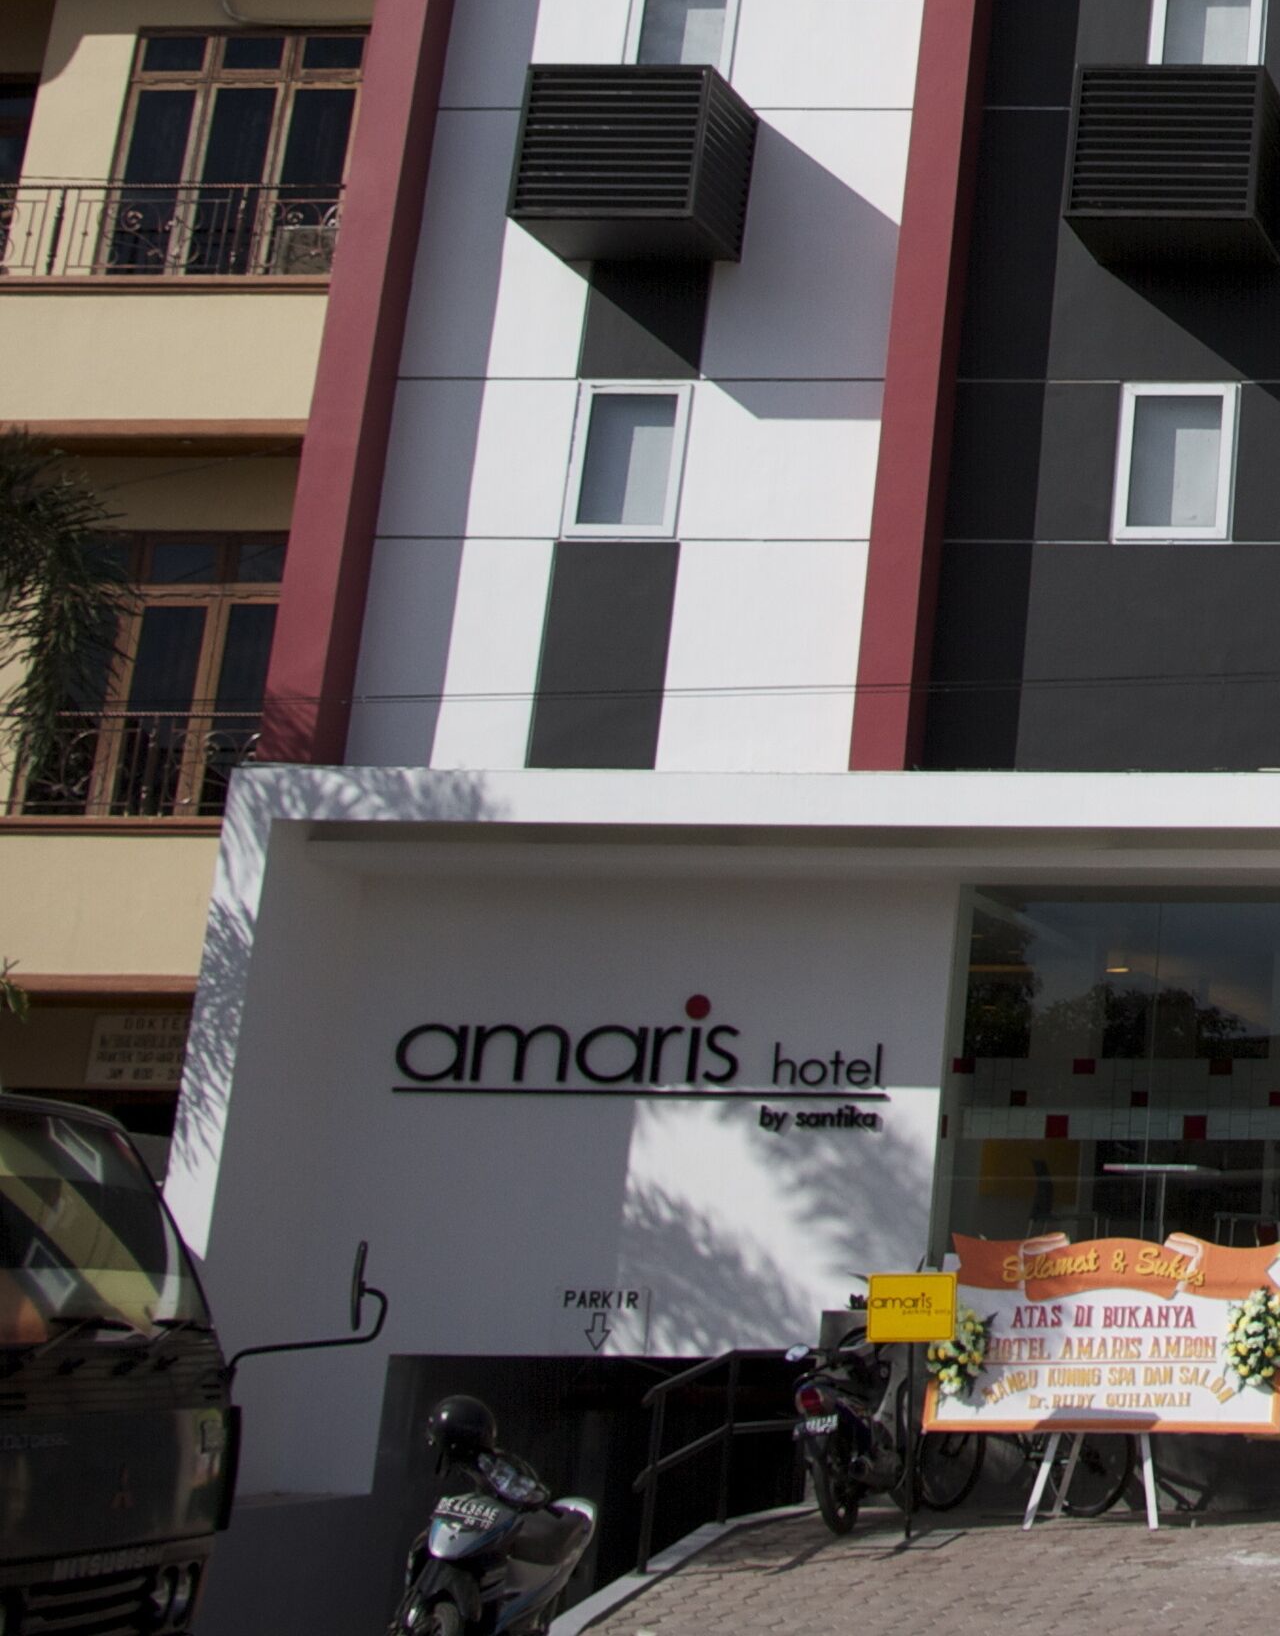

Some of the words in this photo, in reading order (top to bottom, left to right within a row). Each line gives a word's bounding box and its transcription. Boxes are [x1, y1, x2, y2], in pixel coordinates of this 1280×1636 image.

[395, 994, 740, 1084] amaris
[772, 1042, 883, 1086] hotel
[758, 1106, 786, 1132] by
[795, 1105, 878, 1129] santika
[1003, 1248, 1099, 1283] Selamat
[1111, 1250, 1127, 1275] &
[1135, 1247, 1205, 1287] Sukses
[563, 1290, 639, 1309] PARKIR
[871, 1292, 932, 1309] amaris
[1011, 1305, 1062, 1329] ATAS
[1074, 1306, 1094, 1328] DI
[1102, 1305, 1196, 1328] BUKANYA
[987, 1337, 1050, 1361] HOTEL
[1060, 1336, 1142, 1360] AMARIS
[1148, 1336, 1217, 1359] AMBON
[1048, 1367, 1101, 1387] KUNING
[1108, 1367, 1136, 1386] SPA
[1143, 1366, 1174, 1385] DAN
[1051, 1392, 1096, 1409] RUDY
